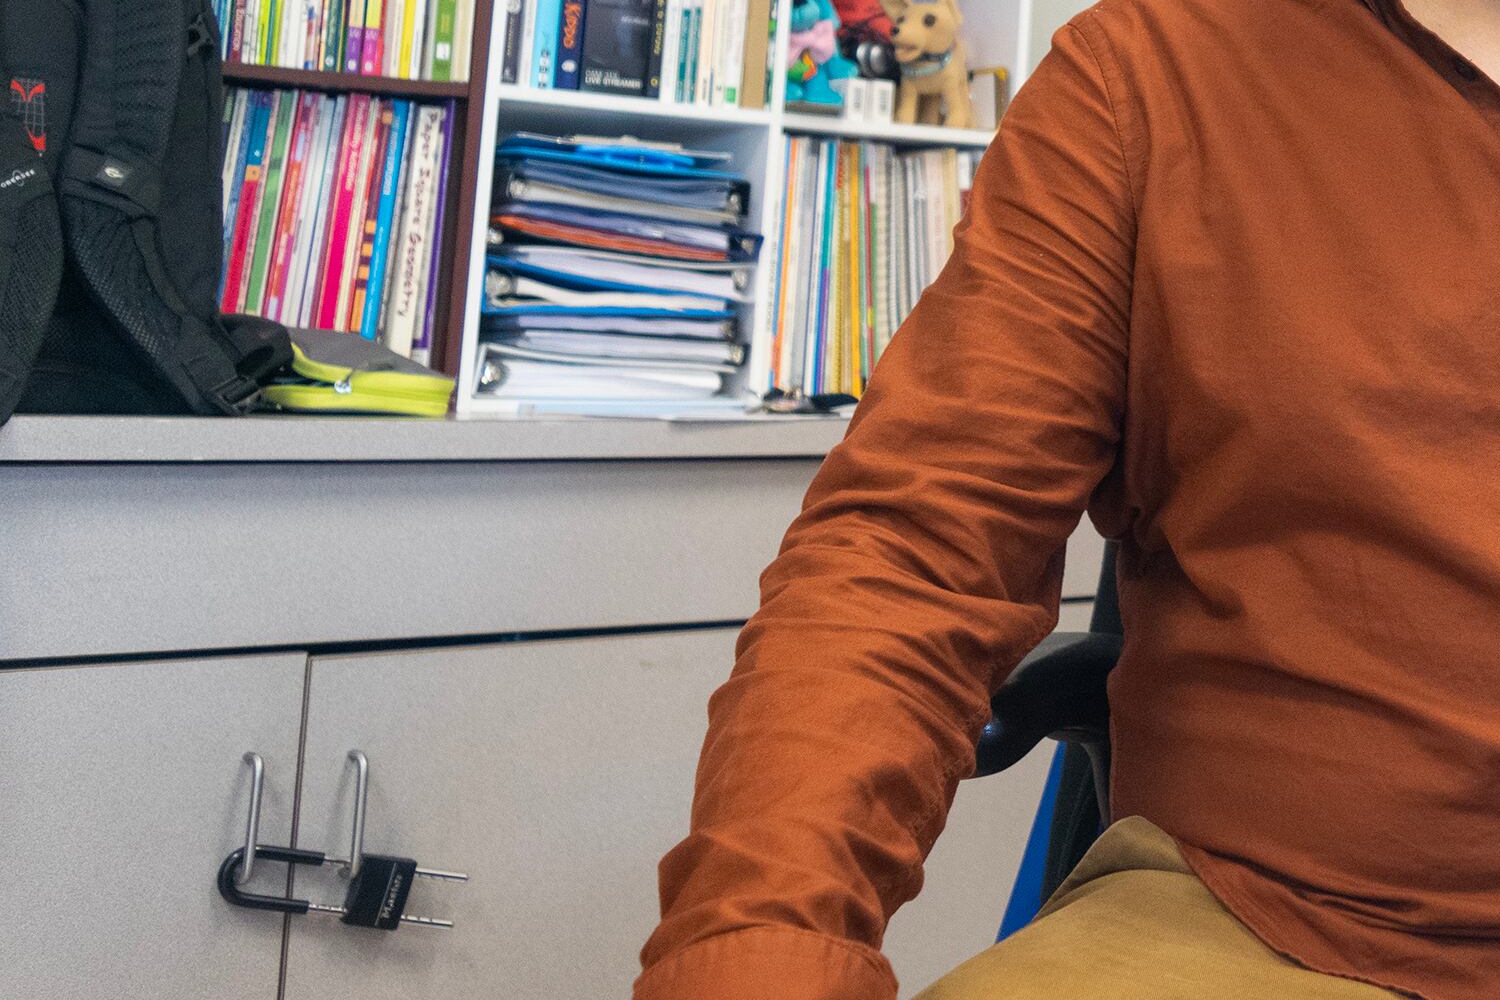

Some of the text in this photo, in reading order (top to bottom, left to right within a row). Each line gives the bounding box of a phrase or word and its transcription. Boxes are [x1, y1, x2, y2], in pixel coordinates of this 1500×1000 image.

[561, 2, 582, 49] KIDDO
[396, 111, 437, 318] Paper Square Geometry
